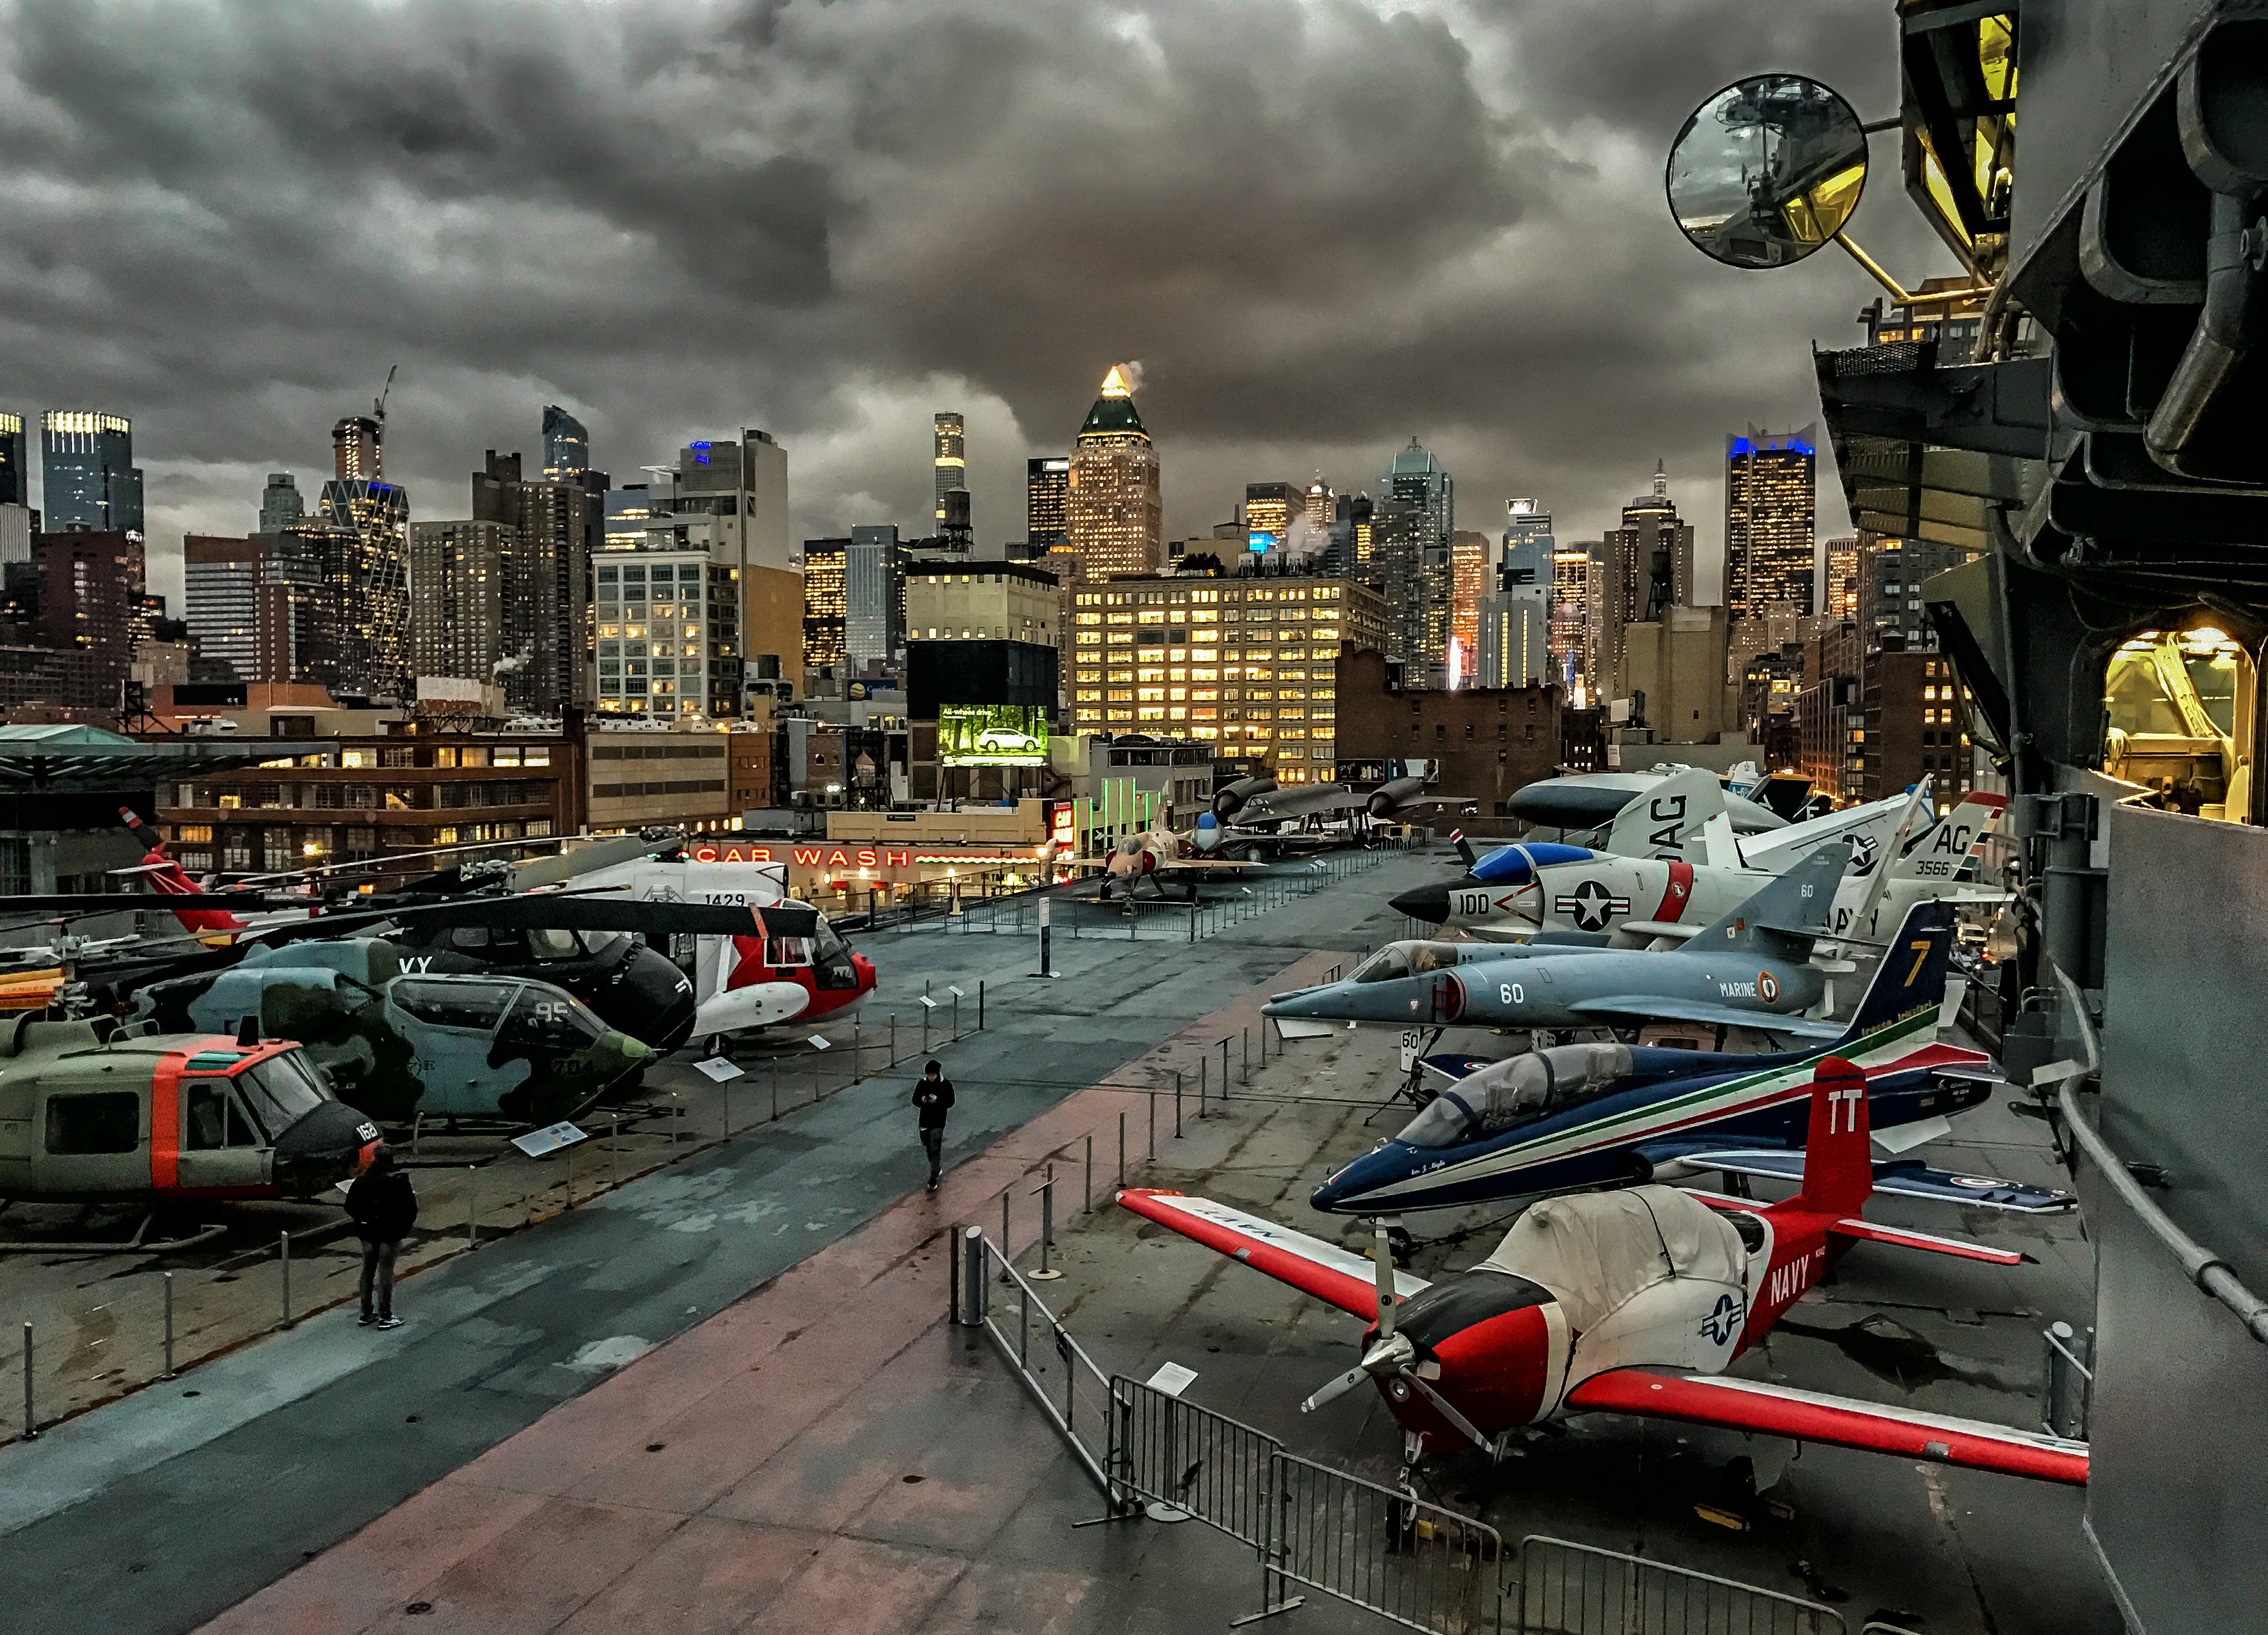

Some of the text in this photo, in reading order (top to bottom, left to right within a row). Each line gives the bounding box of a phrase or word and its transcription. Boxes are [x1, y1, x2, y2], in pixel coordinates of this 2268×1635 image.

[1933, 824, 1970, 855] AG
[695, 846, 908, 867] CAR WASH
[1915, 861, 1950, 876] 3566
[705, 894, 745, 907] 1429
[1801, 884, 1814, 898] 60
[1459, 893, 1489, 916] 100
[1904, 940, 1931, 987] 7
[1500, 983, 1524, 1004] 60
[1719, 982, 1757, 997] MARINE
[1402, 1032, 1418, 1049] 60
[1828, 1089, 1863, 1135] TT
[1770, 1254, 1810, 1307] NAVY
